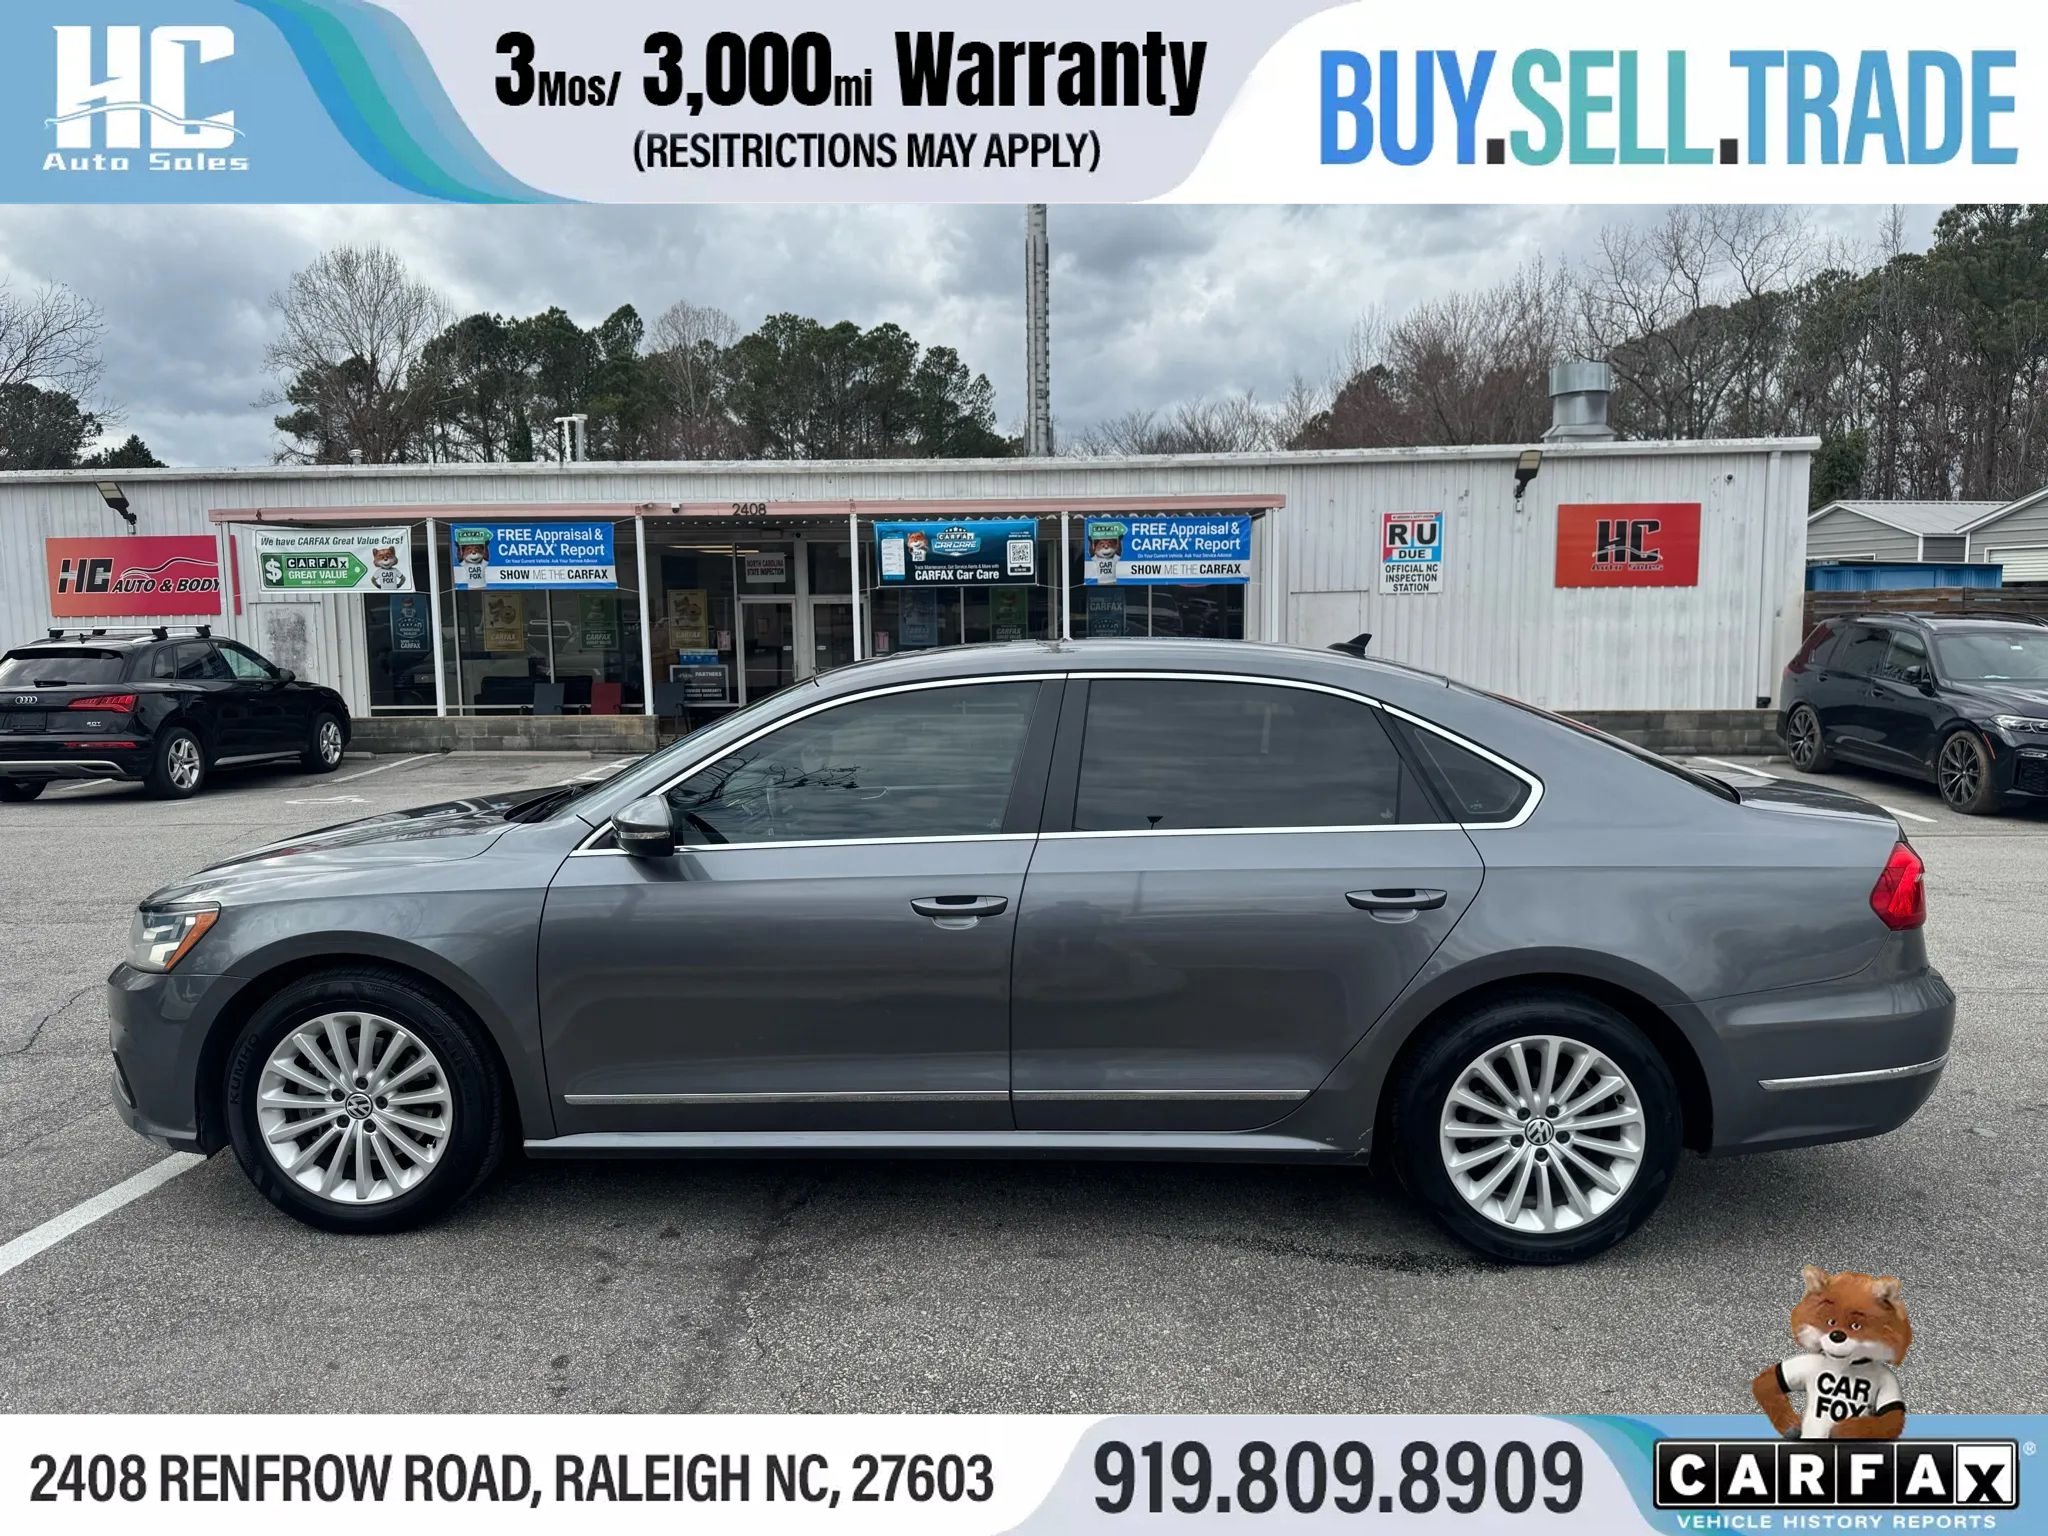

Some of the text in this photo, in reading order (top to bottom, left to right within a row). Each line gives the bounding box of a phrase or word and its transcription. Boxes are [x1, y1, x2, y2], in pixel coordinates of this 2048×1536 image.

[732, 503, 767, 516] 2408
[1131, 522, 1240, 538] FREE Appraisal &
[260, 535, 404, 546] We have CARFAX Great Value Cars!
[497, 528, 604, 544] FREE Appraisal &
[937, 532, 975, 540] CARFAX
[1596, 519, 1661, 564] HC
[498, 543, 605, 558] CARFAX Report
[1131, 538, 1240, 553] CARFAX Report
[1399, 549, 1426, 559] DUE
[287, 558, 348, 569] CARFAX
[1131, 563, 1241, 575] SHOW ME THE CARFAX
[1385, 563, 1438, 573] OFFICIAL NC
[57, 557, 221, 595] HC AUTO & BODY
[288, 569, 348, 580] GREAT VALUE
[500, 569, 608, 580] SHOW ME THE CARFAX
[914, 569, 1000, 581] CARFAX Car Care
[1385, 573, 1438, 583] INSPECTION
[1393, 583, 1430, 592] STATION
